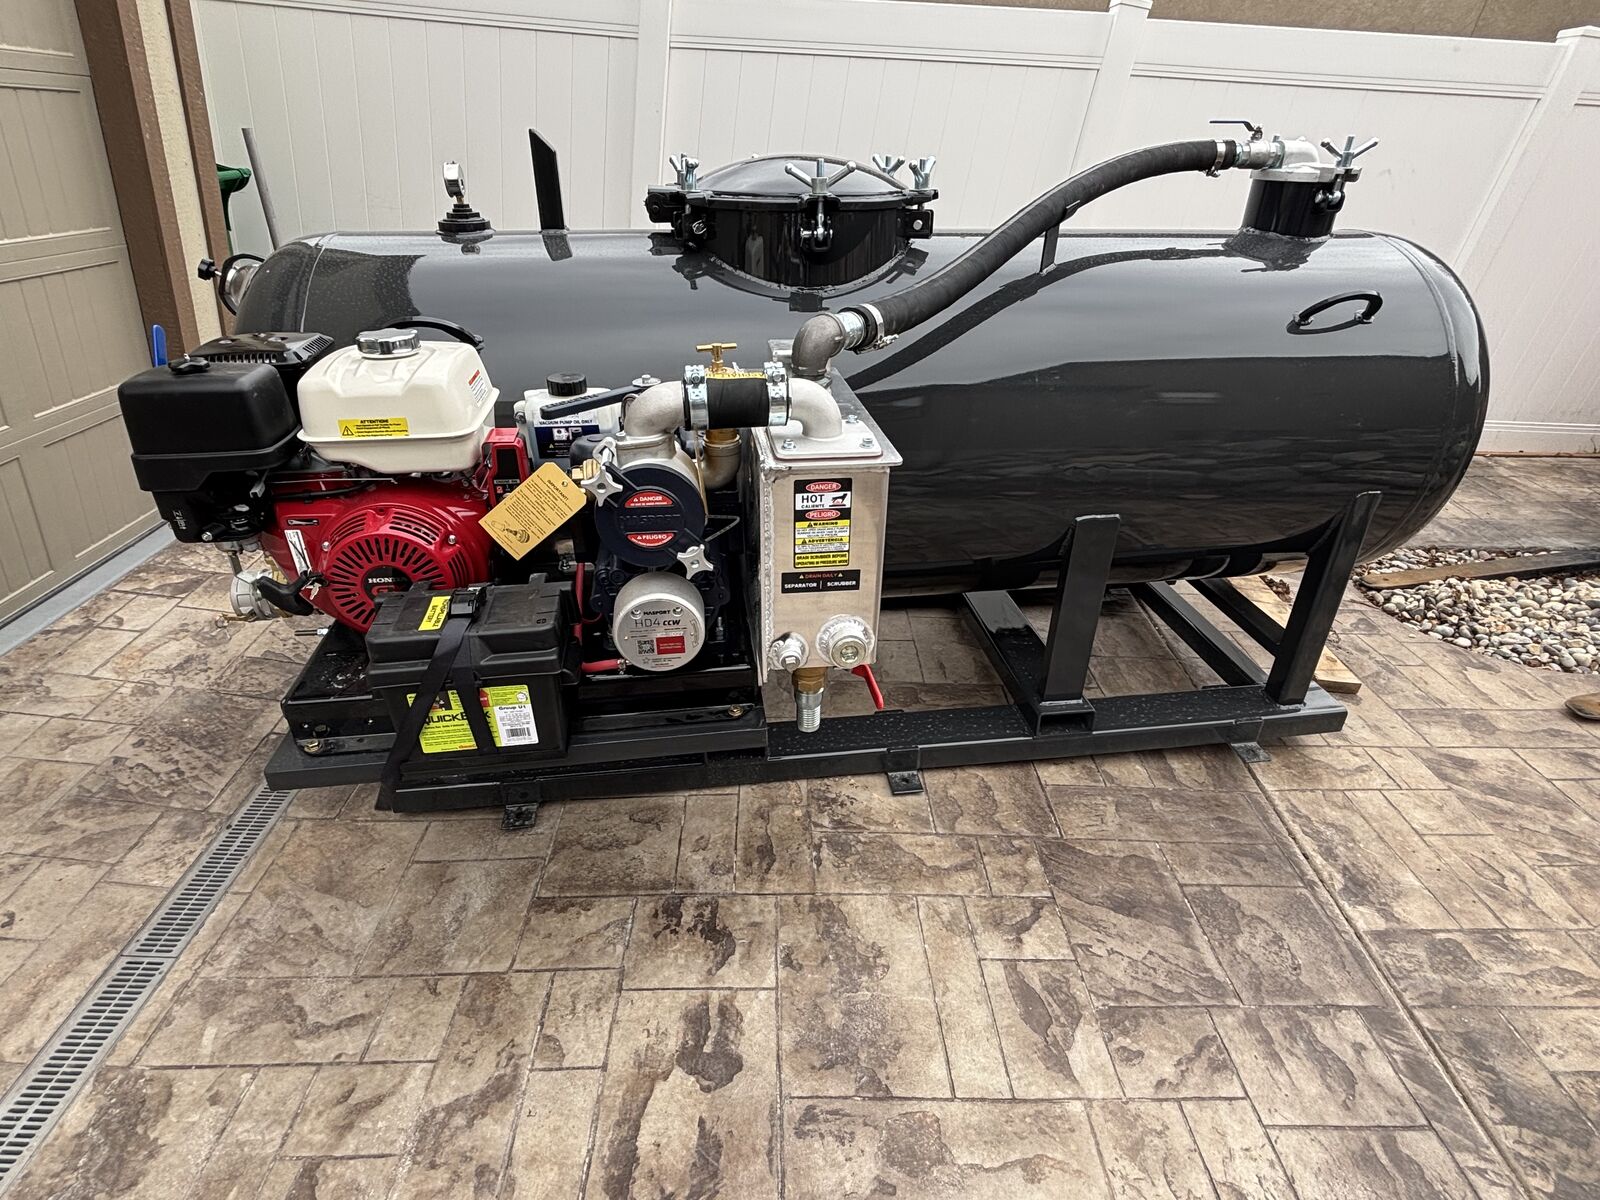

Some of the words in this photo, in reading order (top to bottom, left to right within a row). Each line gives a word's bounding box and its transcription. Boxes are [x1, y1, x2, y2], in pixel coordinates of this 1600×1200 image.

[801, 494, 825, 504] HOT
[634, 618, 660, 628] HD4
[425, 711, 468, 725] UICKB
